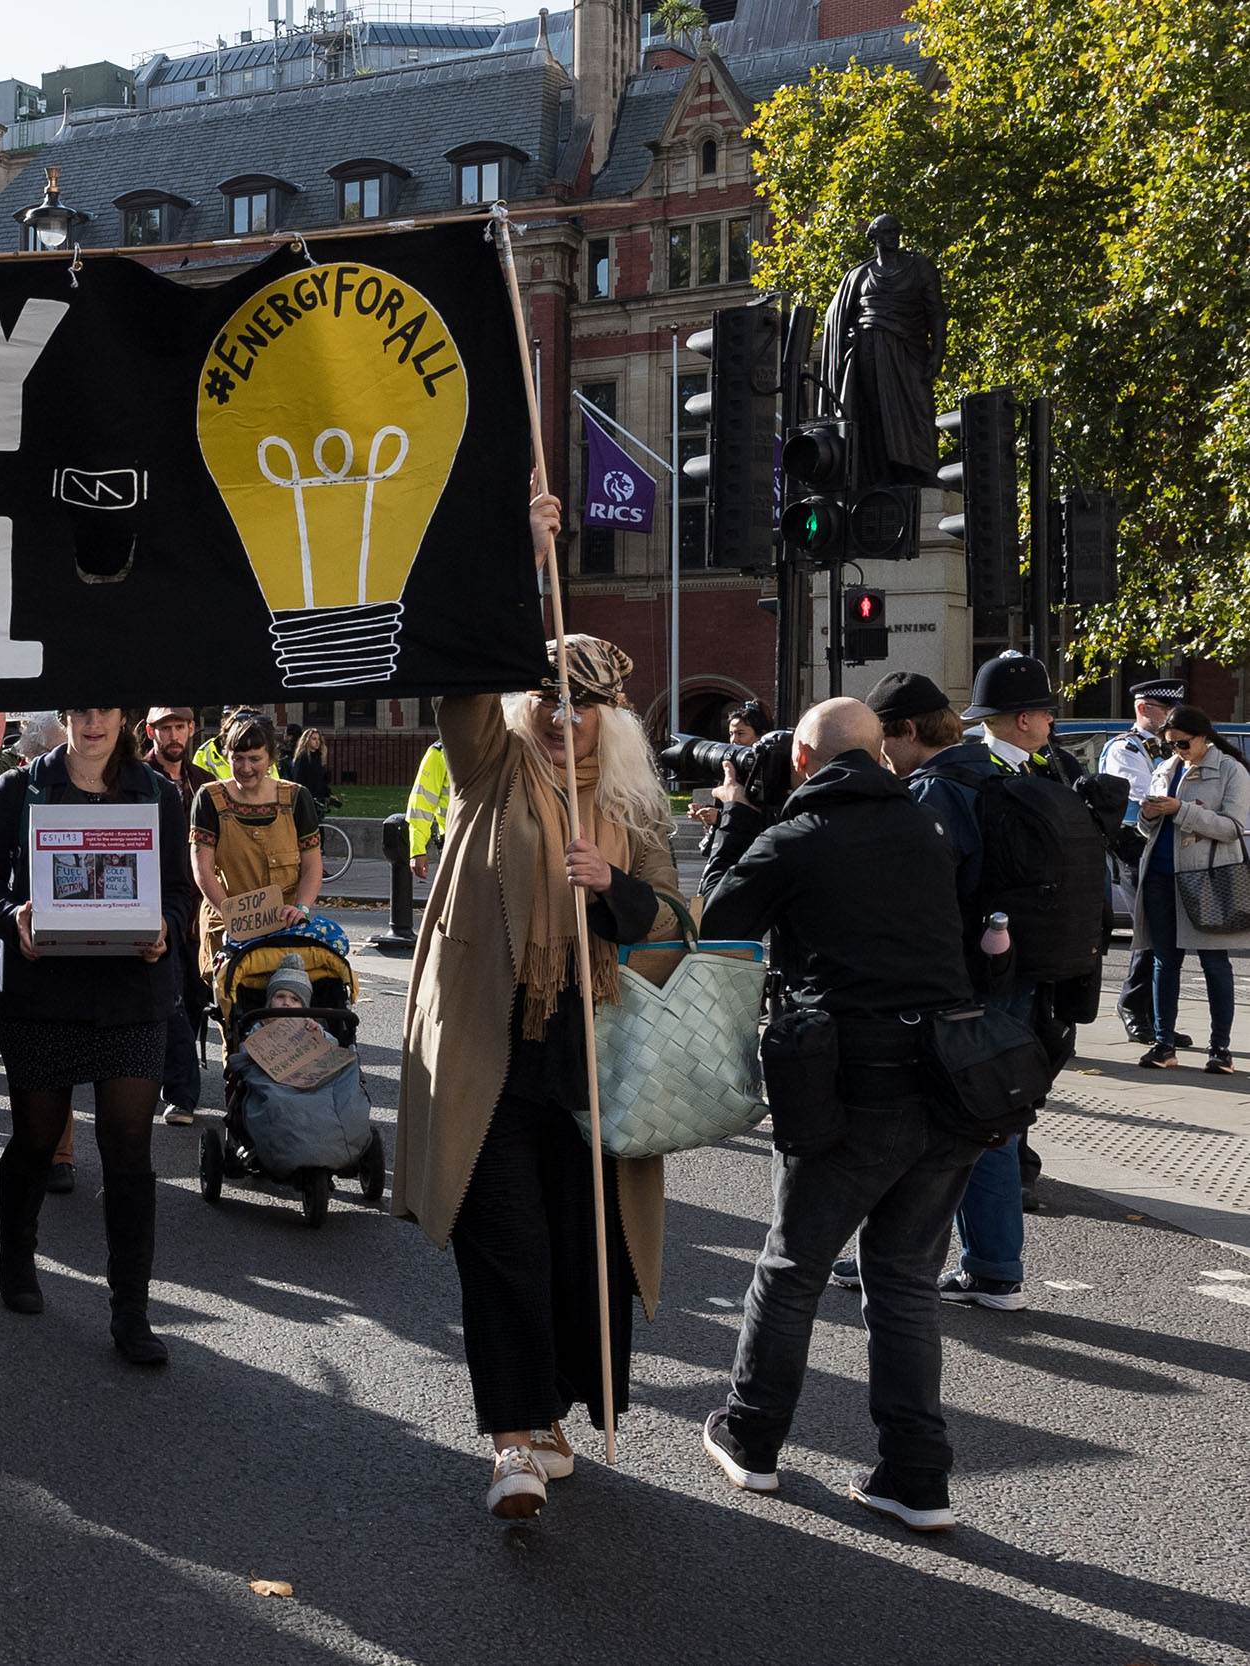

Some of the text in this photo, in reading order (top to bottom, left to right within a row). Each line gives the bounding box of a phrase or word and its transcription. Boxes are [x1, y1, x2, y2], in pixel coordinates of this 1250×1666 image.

[590, 502, 643, 523] RICS
[888, 623, 936, 633] ANNING
[56, 865, 82, 876] FUEL
[238, 892, 266, 911] STOP
[231, 906, 278, 933] ROSEBANK
